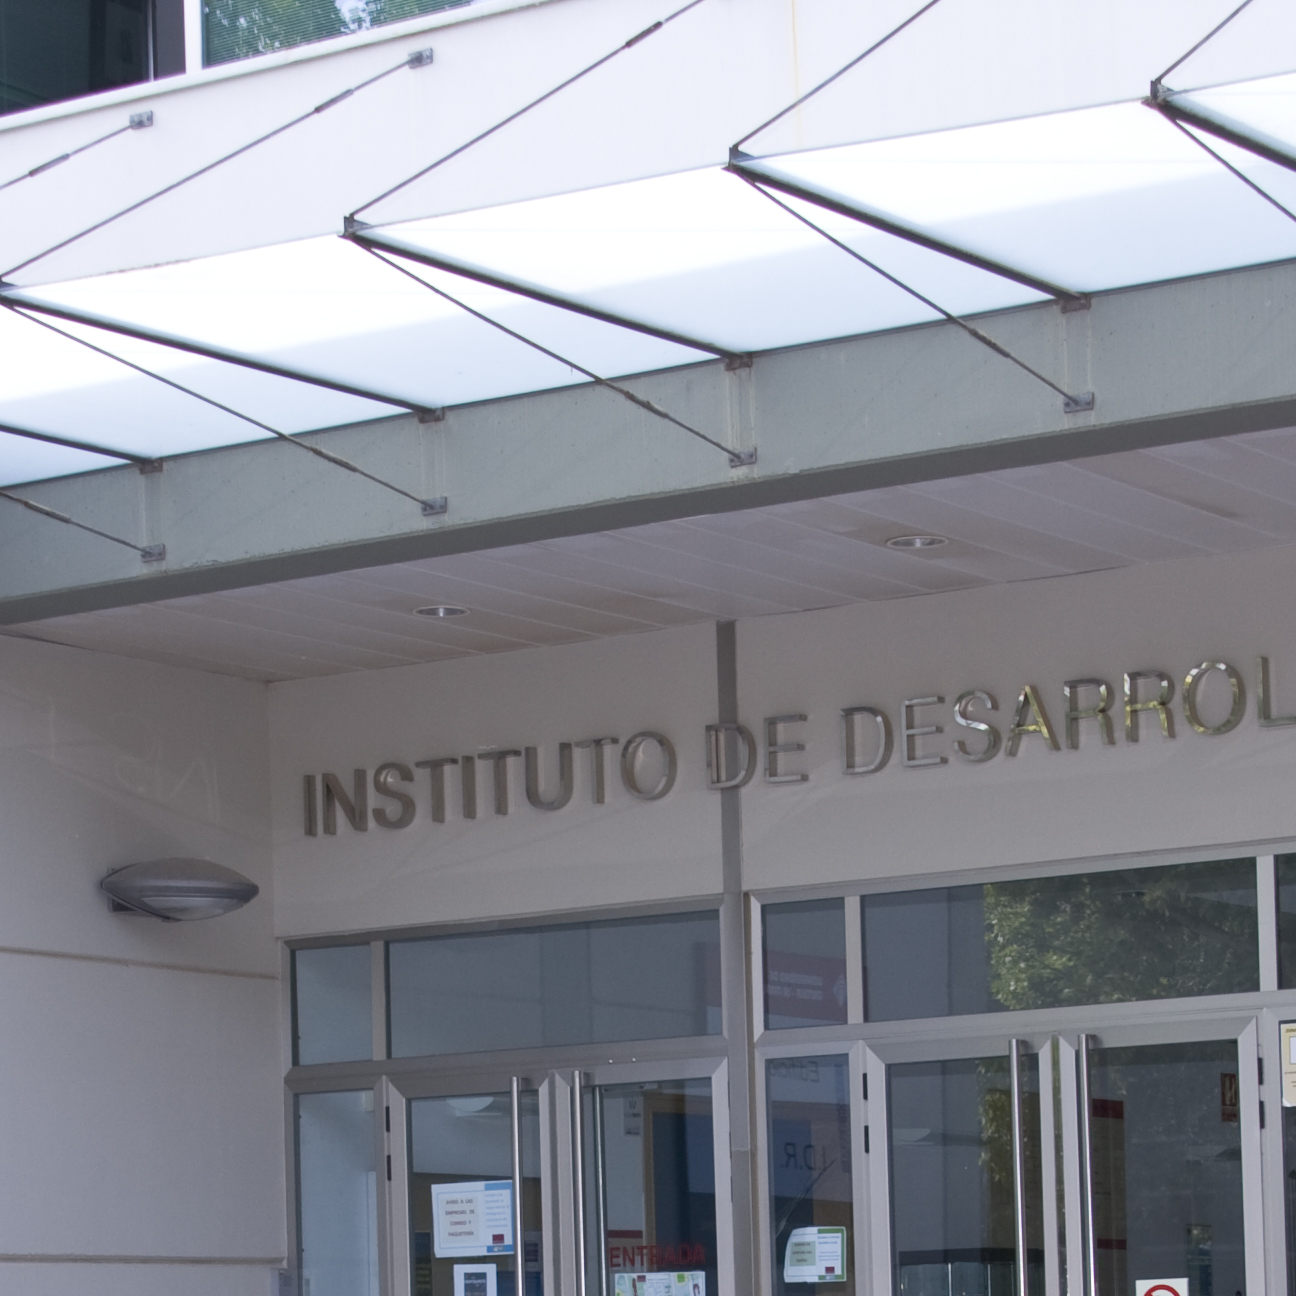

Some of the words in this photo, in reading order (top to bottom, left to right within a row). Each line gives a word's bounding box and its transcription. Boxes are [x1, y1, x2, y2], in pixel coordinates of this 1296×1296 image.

[302, 731, 679, 838] INSTITUTO
[705, 713, 810, 790] DE
[609, 1242, 706, 1268] ENTRADA
